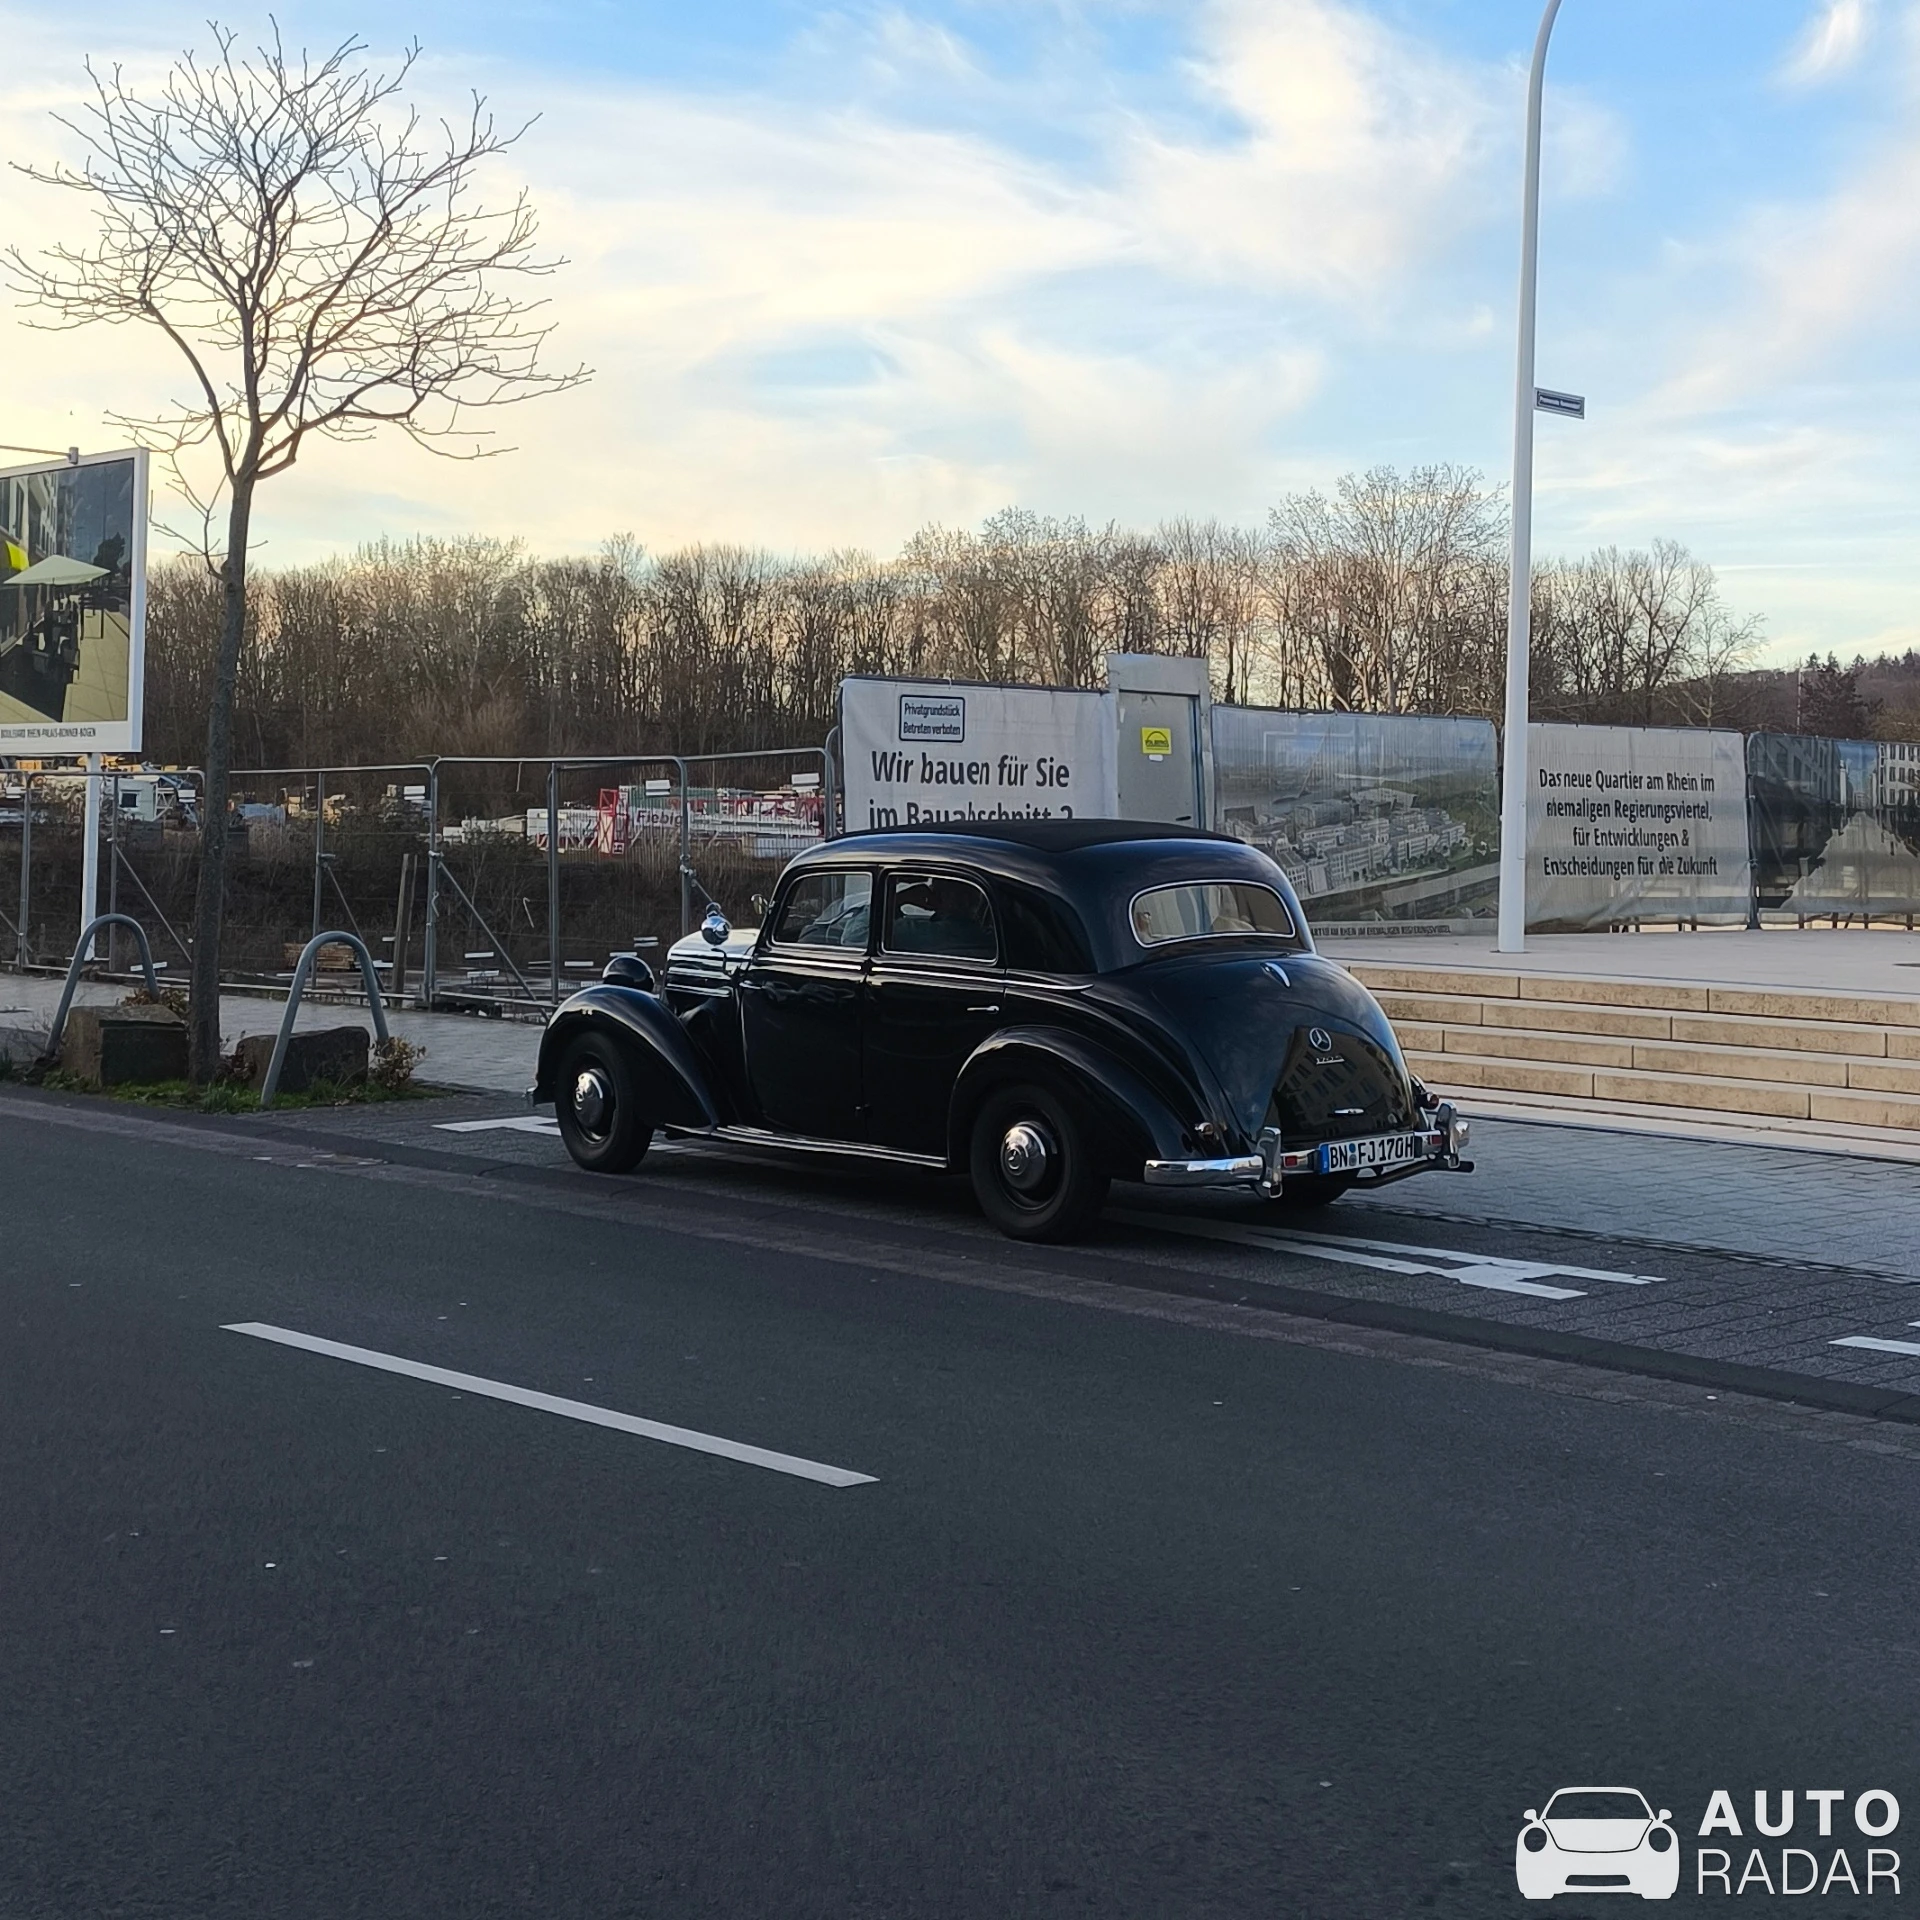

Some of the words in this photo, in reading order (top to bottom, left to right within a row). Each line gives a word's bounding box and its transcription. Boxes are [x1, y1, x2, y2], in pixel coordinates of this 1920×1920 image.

[904, 703, 960, 718] Privatgrundstück
[904, 722, 931, 734] Betreten
[932, 723, 960, 735] verboten
[872, 751, 914, 782] Wir
[920, 752, 990, 784] bauen
[998, 755, 1028, 786] für
[1036, 757, 1070, 788] Sie
[1539, 768, 1562, 788] Das
[1563, 772, 1592, 788] neue
[1595, 769, 1644, 793] Quartier
[1646, 776, 1664, 790] am
[1667, 772, 1699, 792] Rhein
[1700, 773, 1715, 792] im
[869, 799, 898, 829] im
[1546, 798, 1611, 822] ehemaligen
[1614, 800, 1713, 822] Regierungsviertel,
[1572, 827, 1590, 847] für
[1594, 827, 1678, 852] Entwicklungen
[1681, 829, 1690, 846] &
[1544, 856, 1634, 880] Entscheidungen
[1638, 856, 1654, 876] für
[1658, 856, 1674, 875] die
[1677, 856, 1718, 876] Zukunft
[1330, 1145, 1348, 1168] BN
[1358, 1141, 1375, 1164] FJ
[1378, 1136, 1414, 1161] 170H
